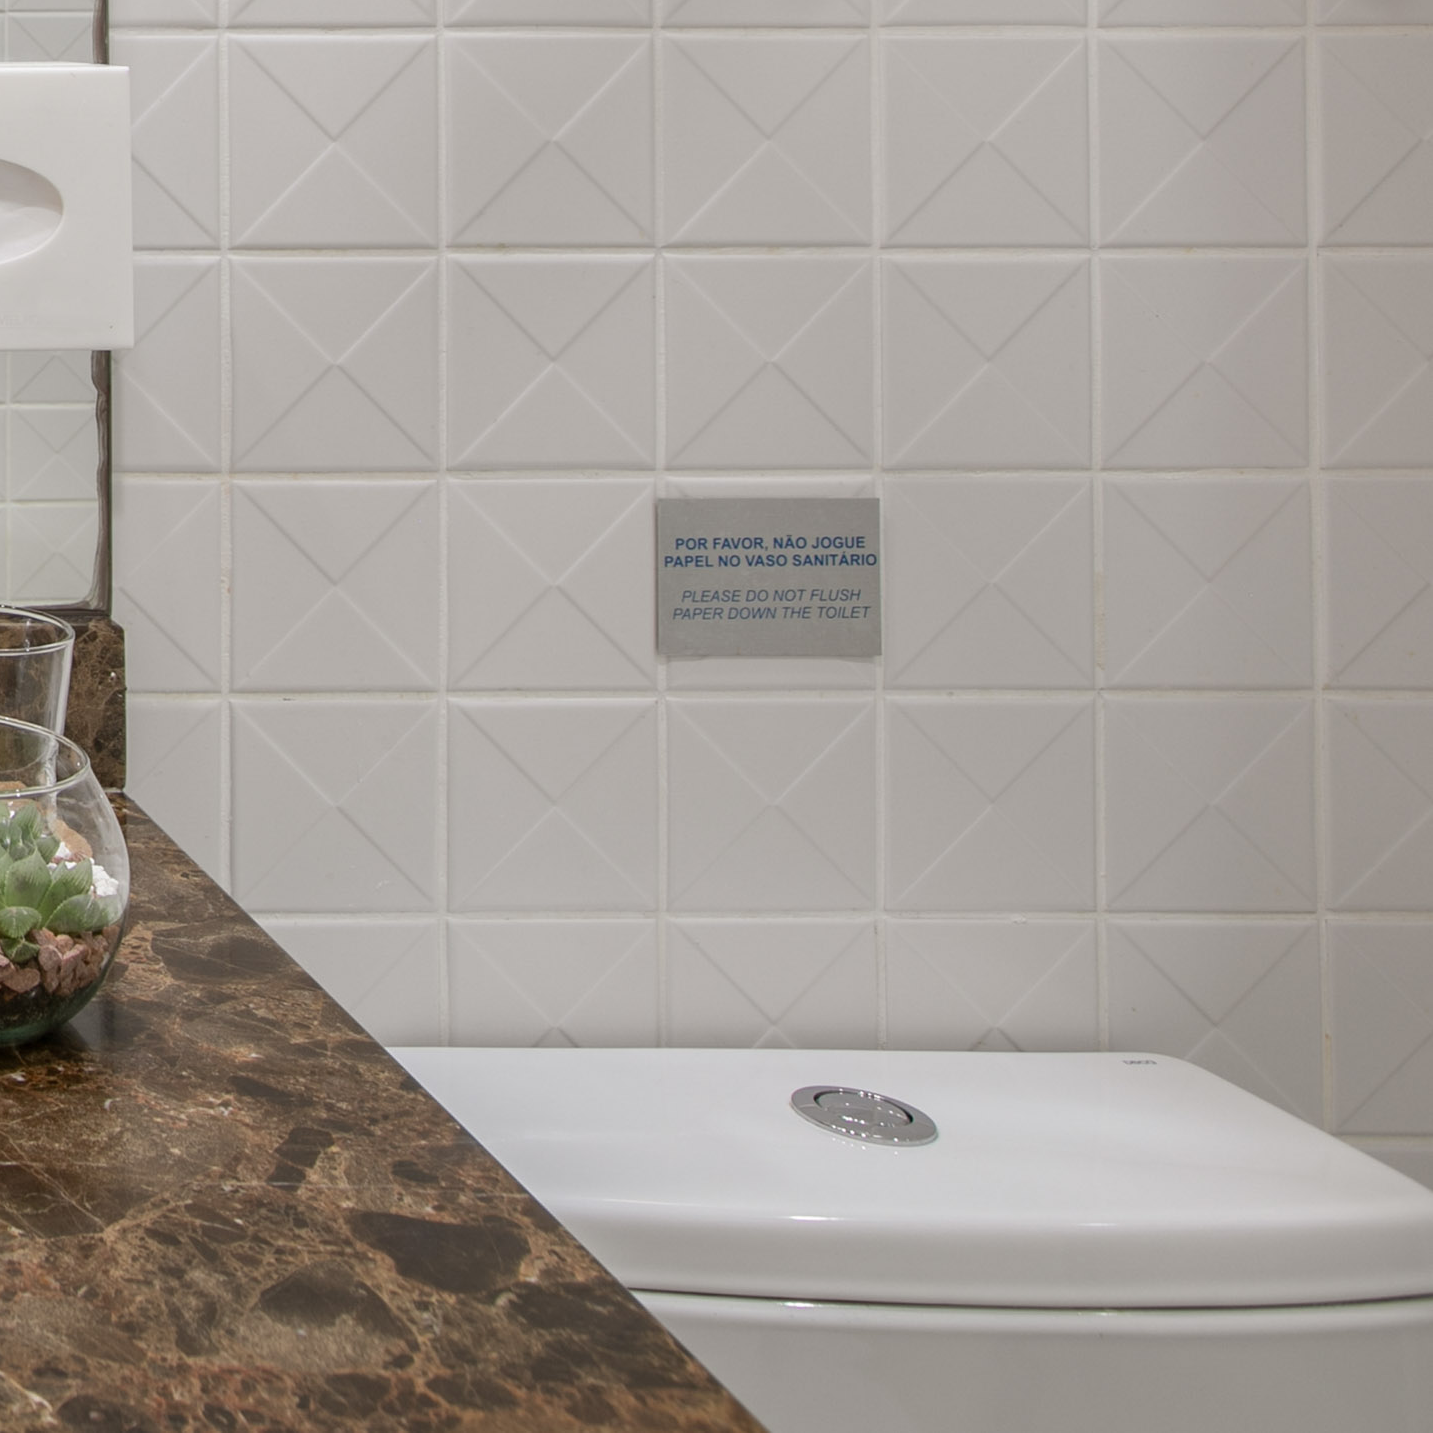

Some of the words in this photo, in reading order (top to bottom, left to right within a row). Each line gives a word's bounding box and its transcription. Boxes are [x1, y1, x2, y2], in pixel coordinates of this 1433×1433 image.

[675, 537, 708, 551] POR
[713, 537, 768, 552] FAVOR,
[773, 535, 807, 549] NÃO
[811, 536, 866, 549] JOGUE
[664, 555, 714, 568] PAPEL
[718, 554, 741, 567] NO
[745, 554, 788, 567] VASO
[792, 551, 877, 567] SANITÁRIO
[681, 589, 741, 603] PLEASE
[745, 589, 769, 603] DO
[773, 588, 806, 602] NOT
[809, 588, 862, 601] FLUSH
[673, 607, 724, 620] PAPER
[727, 606, 777, 620] DOWN
[782, 606, 812, 619] THE
[818, 605, 871, 619] TOILET
